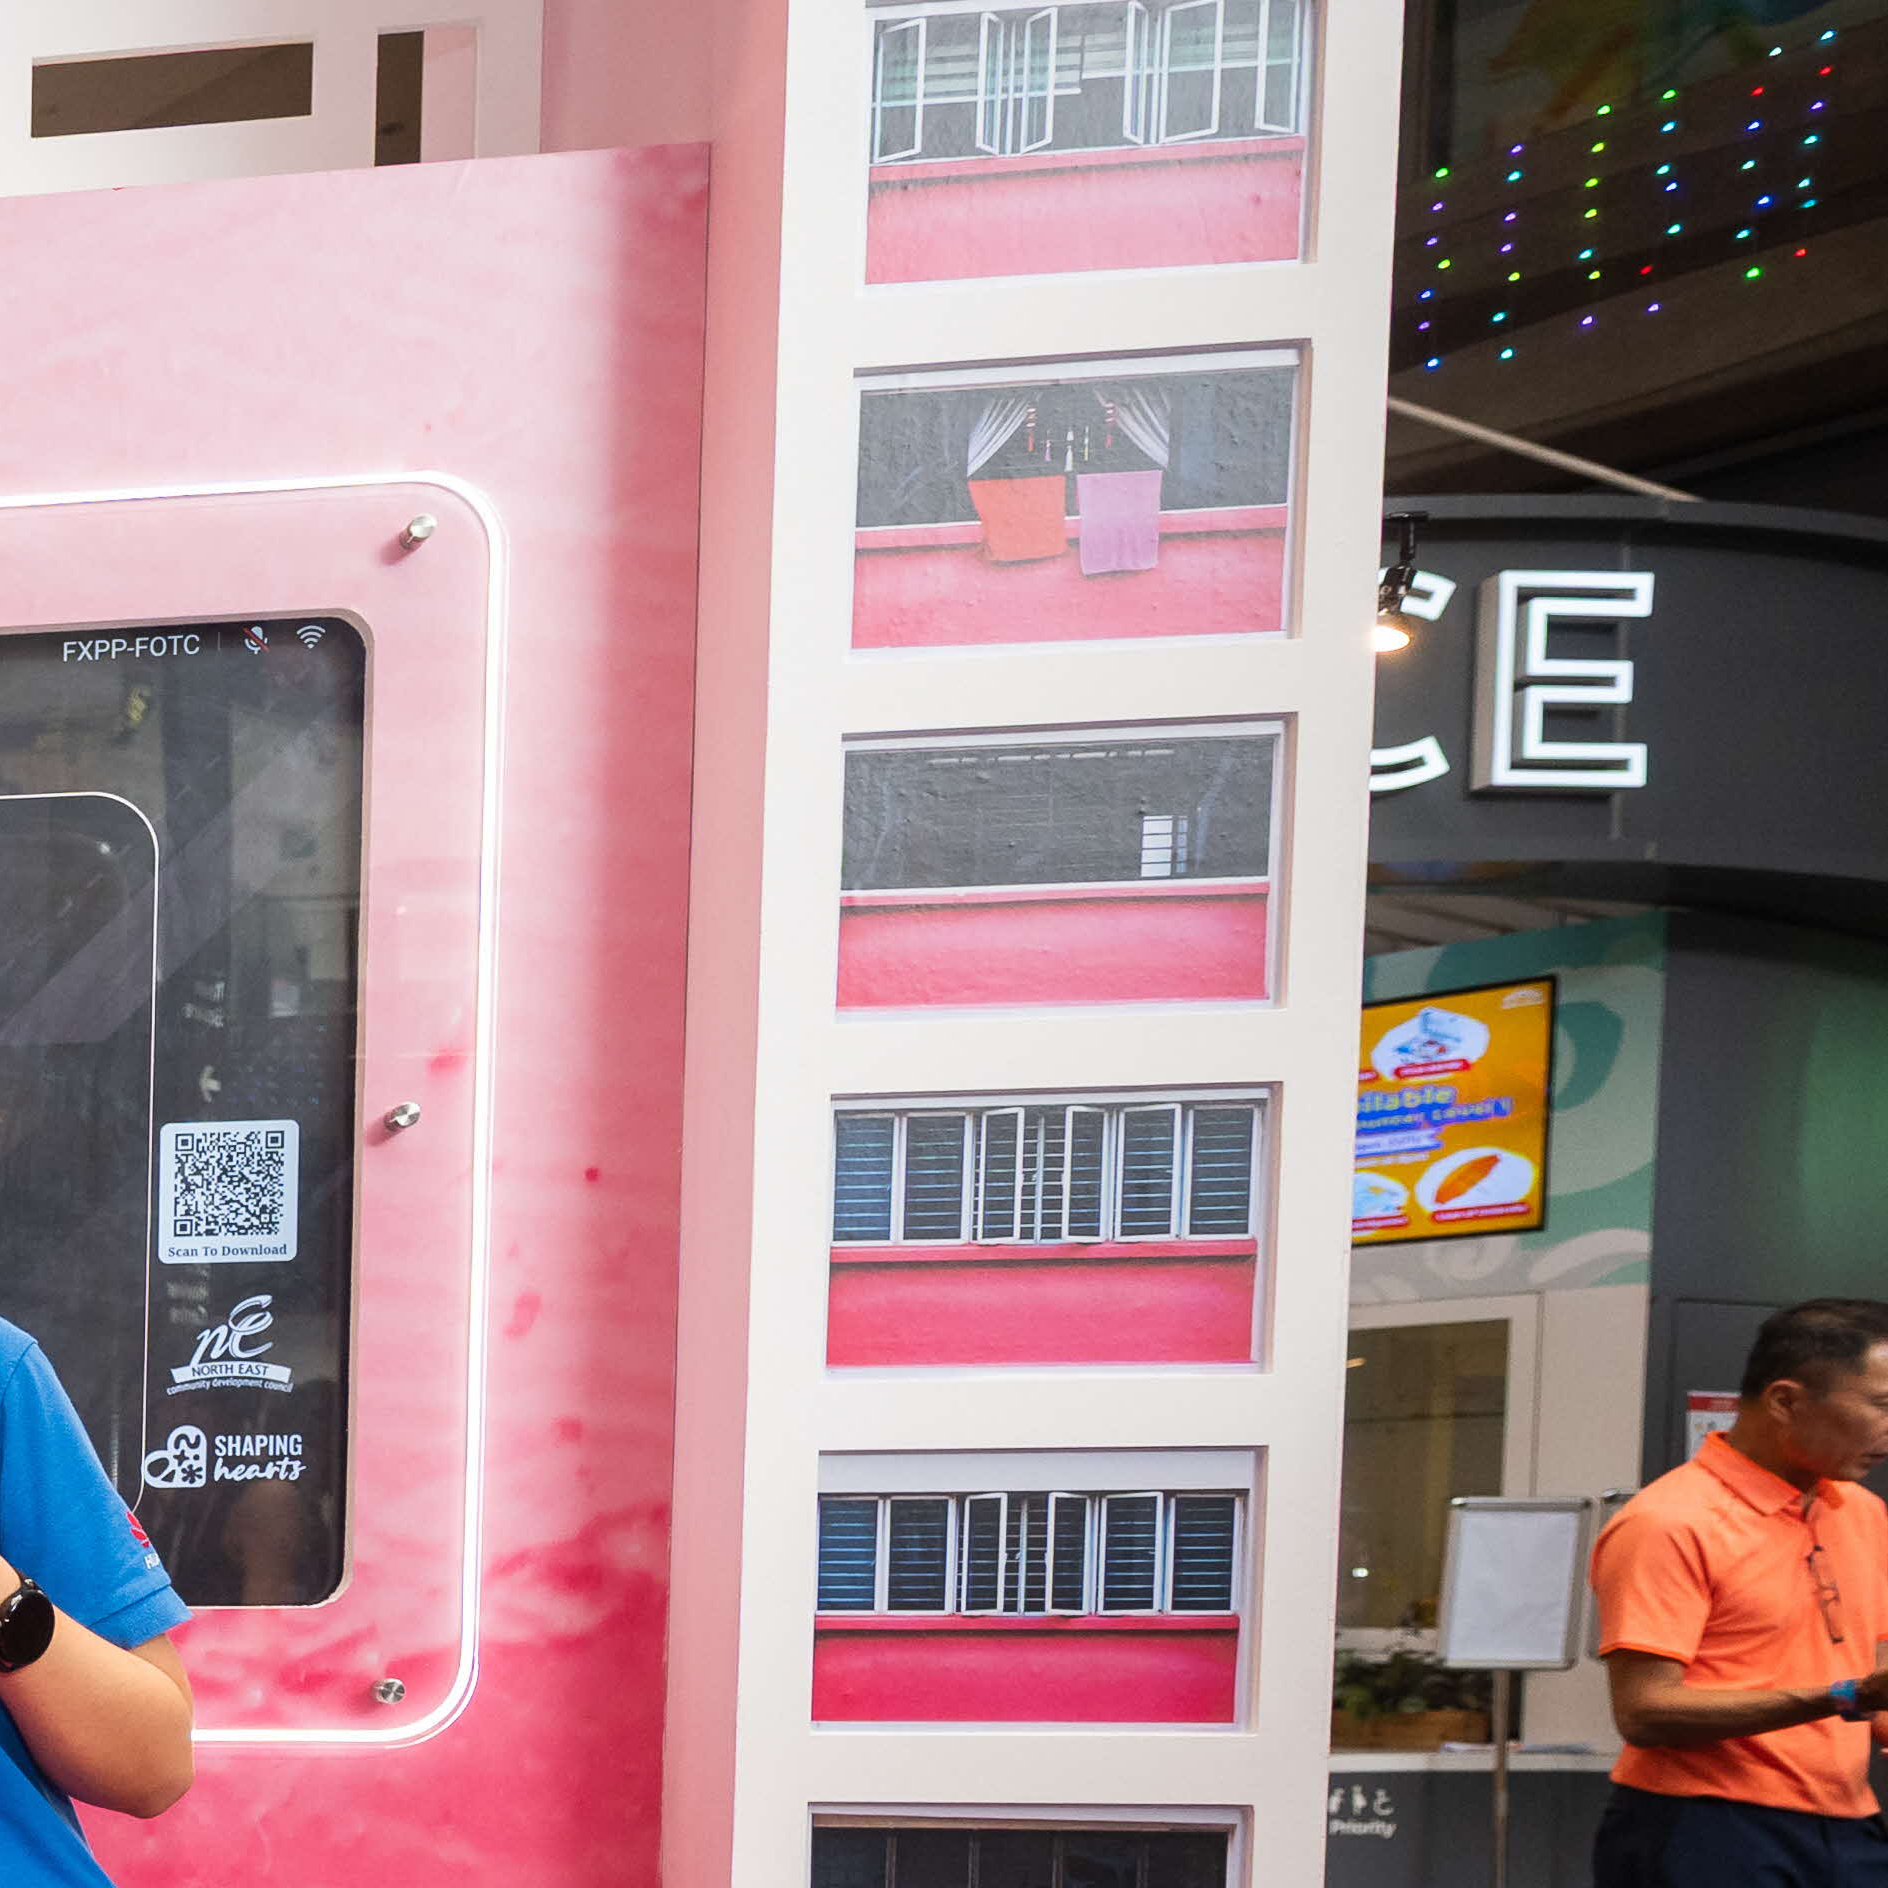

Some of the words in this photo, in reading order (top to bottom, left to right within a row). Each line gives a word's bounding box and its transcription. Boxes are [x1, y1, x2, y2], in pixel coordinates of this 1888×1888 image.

[63, 633, 200, 662] FXPP-FOTC
[168, 1246, 198, 1257] Scan
[203, 1246, 219, 1257] To
[222, 1244, 287, 1257] Download
[191, 1364, 234, 1377] NORTH
[238, 1364, 270, 1376] EAST
[215, 1434, 303, 1457] SHAPING
[213, 1457, 307, 1482] hearts
